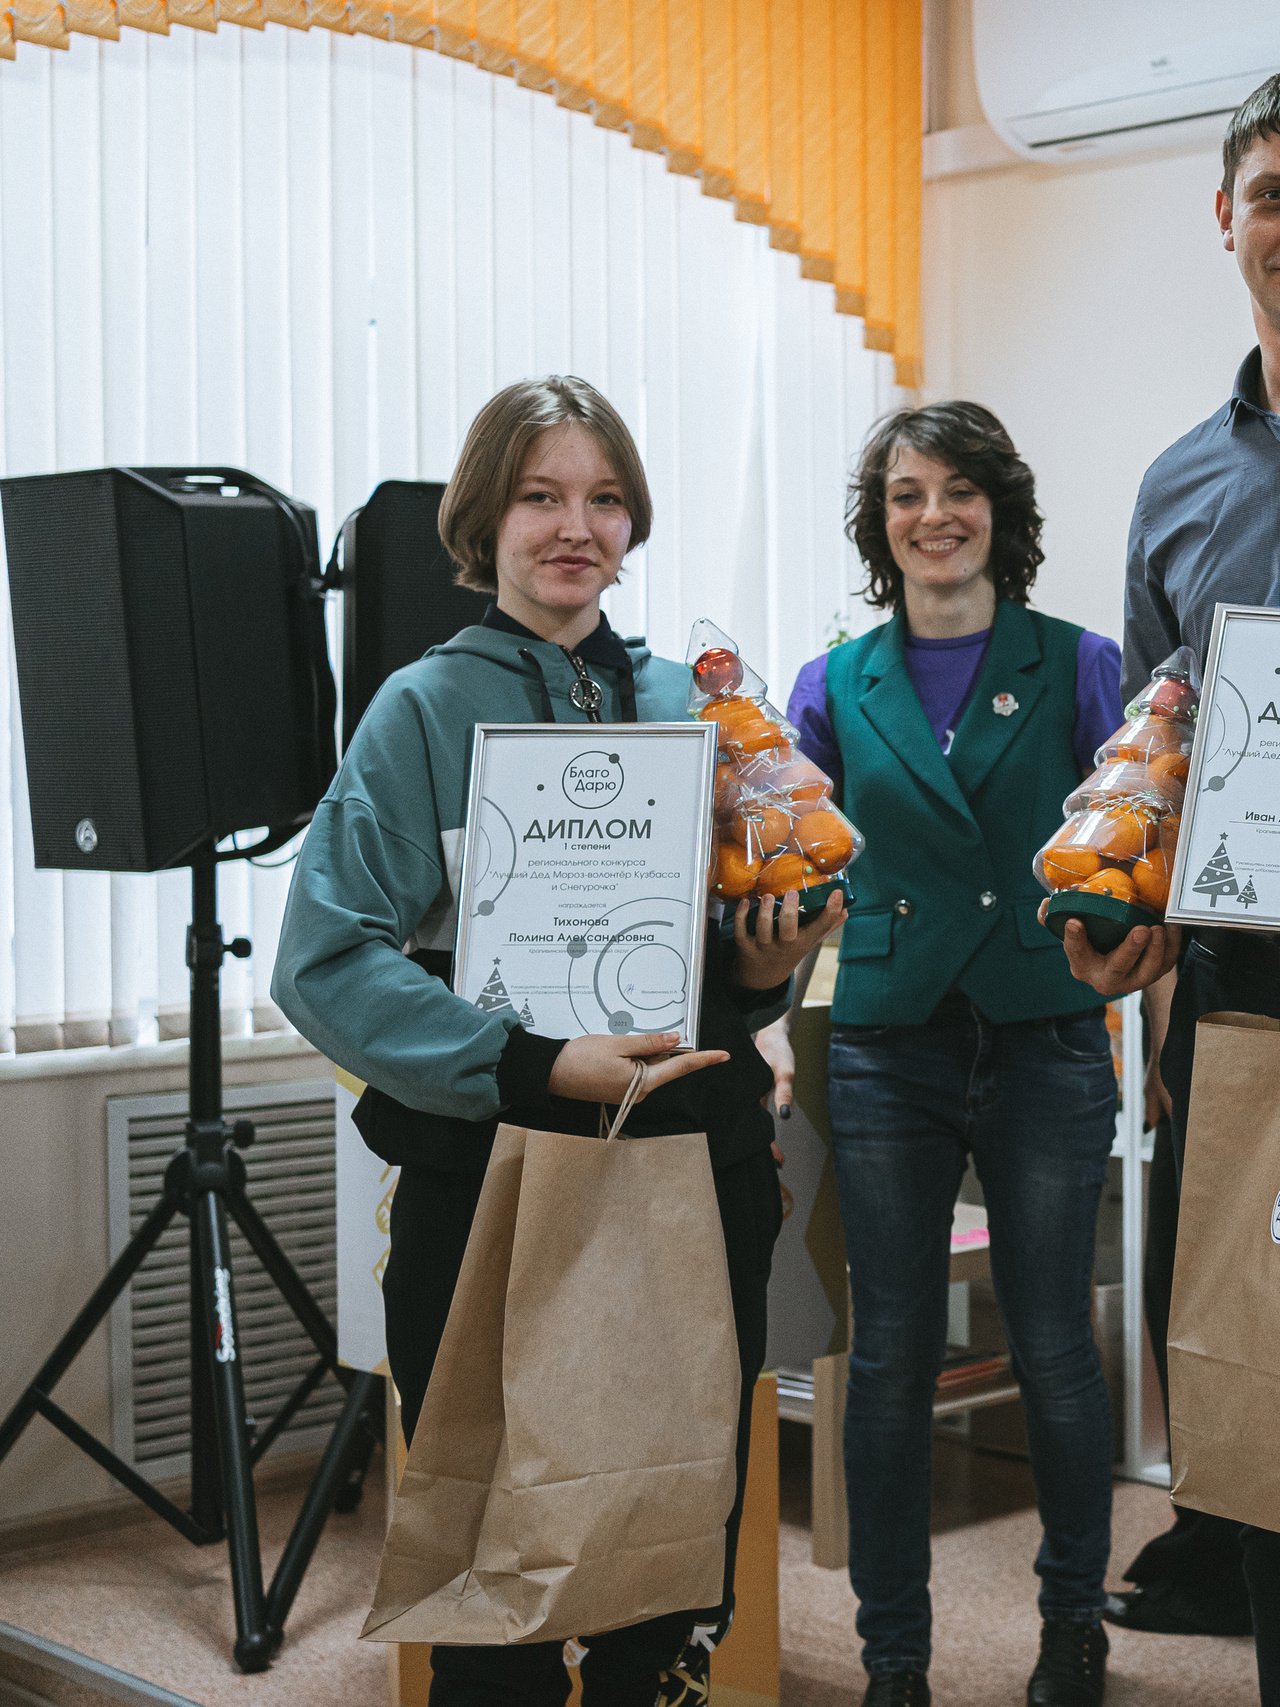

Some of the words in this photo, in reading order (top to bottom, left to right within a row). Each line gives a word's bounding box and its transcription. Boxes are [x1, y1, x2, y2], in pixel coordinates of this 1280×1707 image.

[569, 766, 610, 778] Благо
[574, 778, 617, 793] Дарю
[1244, 811, 1276, 823] Иван
[523, 819, 652, 843] ДИПЛОМ
[571, 843, 611, 851] степени
[528, 858, 599, 868] регионального
[601, 858, 646, 868] конкурса
[530, 870, 551, 880] Дед
[634, 869, 681, 880] Кузбасса
[558, 902, 607, 910] награждается
[553, 916, 609, 927] Тихонова
[508, 932, 554, 943] Полина
[557, 932, 655, 944] Александровна
